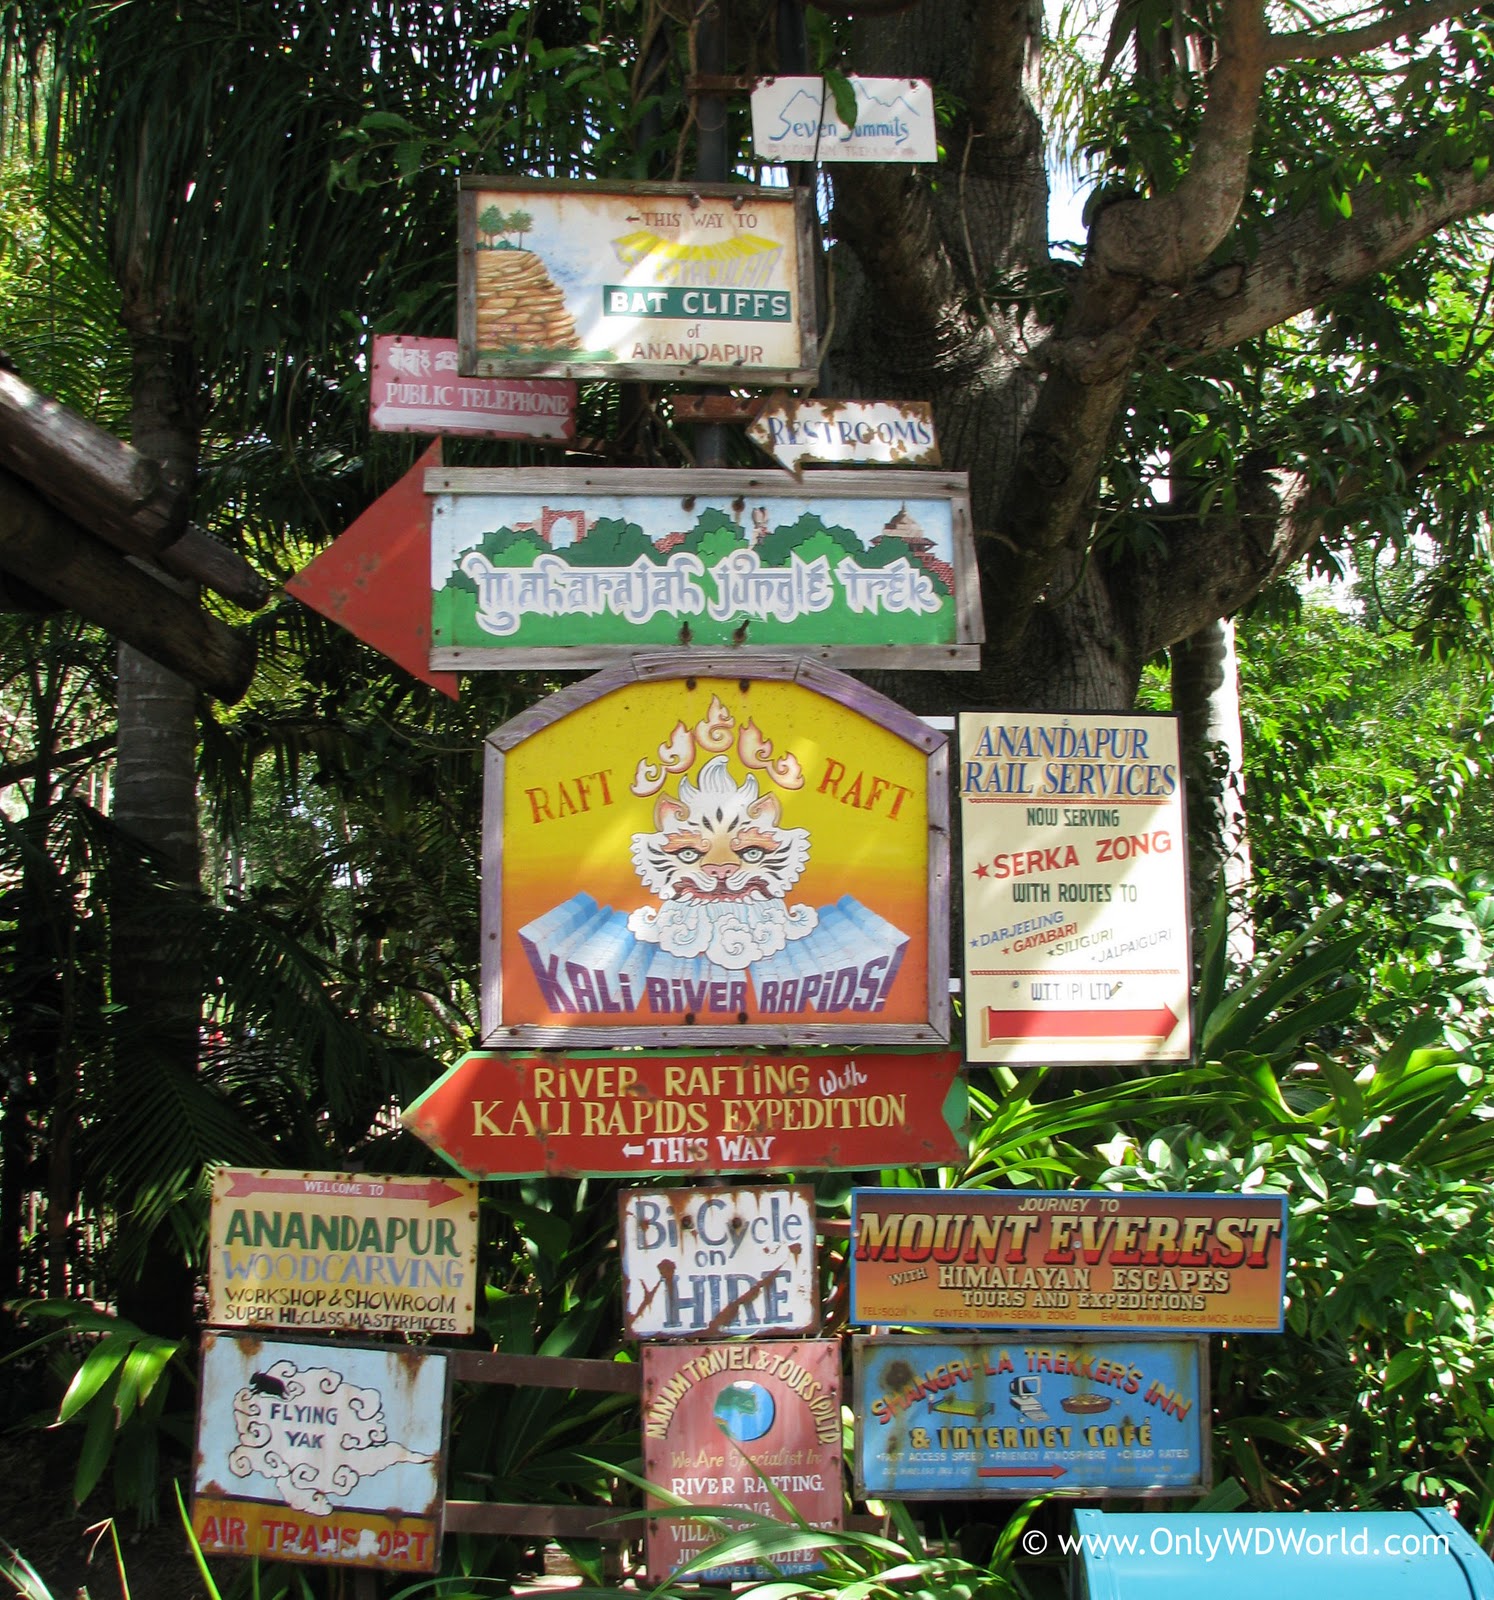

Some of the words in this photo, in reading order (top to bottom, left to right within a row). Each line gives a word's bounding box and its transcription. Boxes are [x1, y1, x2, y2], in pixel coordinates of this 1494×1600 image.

[769, 116, 836, 141] Seven
[642, 212, 681, 227] THIS
[691, 213, 724, 228] WAY
[735, 213, 758, 228] TO
[610, 291, 668, 313] BAT
[682, 291, 788, 317] CLIFFS
[687, 324, 701, 338] of
[632, 342, 763, 363] ANANDAPUR
[385, 382, 454, 406] PUBLIC
[458, 387, 569, 416] TELEPHONE
[768, 417, 932, 446] RESTROOMS
[972, 726, 1149, 761] ANANDAPUR
[816, 757, 914, 821] RAFT
[962, 762, 1034, 796] RAIL
[1043, 763, 1177, 796] SERVICES
[525, 769, 615, 824] RAFT
[1027, 808, 1058, 826] NOW
[1063, 808, 1120, 827] SERVING
[993, 844, 1080, 879] SERKA
[1096, 830, 1172, 863] ZONG
[1012, 883, 1050, 903] WITH
[1058, 883, 1112, 903] ROUTES
[1122, 884, 1138, 903] TO
[979, 910, 1064, 947] DARJEELING
[1013, 922, 1078, 953] GAYABARI
[1056, 928, 1113, 956] SILIGURI
[1098, 929, 1172, 963] JALPAIGURI
[471, 1101, 571, 1138] KALI
[581, 1099, 710, 1137] RAPIDS
[722, 1094, 906, 1133] EXPEDITION
[647, 1136, 709, 1164] THIS
[716, 1134, 776, 1162] WAY
[304, 1180, 362, 1196] WELCOME
[369, 1184, 384, 1196] TO
[1018, 1198, 1090, 1212] JOURNEY
[1100, 1199, 1121, 1212] TO
[225, 1208, 462, 1257] ANANDAPUR
[855, 1212, 1041, 1264] MOUNT
[1043, 1215, 1282, 1268] EVEREST
[222, 1251, 465, 1289] WOODCARVING
[694, 1250, 727, 1267] on
[889, 1267, 929, 1286] WITH
[938, 1265, 1091, 1291] HIMALAYAN
[1112, 1268, 1230, 1293] ESCAPES
[225, 1287, 327, 1307] WORKSHOP
[328, 1288, 342, 1306] &
[344, 1288, 457, 1314] SHOWROOM
[662, 1270, 794, 1328] HIRE
[962, 1290, 1025, 1307] TOURS
[1032, 1291, 1069, 1308] AND
[1077, 1293, 1207, 1310] EXPEDITIONS
[225, 1304, 275, 1321] SUPER
[349, 1312, 457, 1331] MASTERPIECES
[933, 1308, 969, 1319] CENTER
[1025, 1348, 1144, 1394] TREKKER'S
[1144, 1379, 1192, 1422] INN
[270, 1403, 338, 1426] FLYING
[285, 1431, 326, 1449] YAK
[911, 1427, 931, 1449] &
[938, 1426, 1072, 1449] INTERNET
[1086, 1416, 1152, 1447] CAFÉ
[672, 1450, 691, 1468] We
[692, 1449, 724, 1468] Are
[909, 1452, 947, 1461] ACCESS
[1159, 1449, 1190, 1459] RATES
[671, 1477, 735, 1496] RIVER
[200, 1516, 246, 1548] AIR
[262, 1520, 432, 1562] TRANSORT
